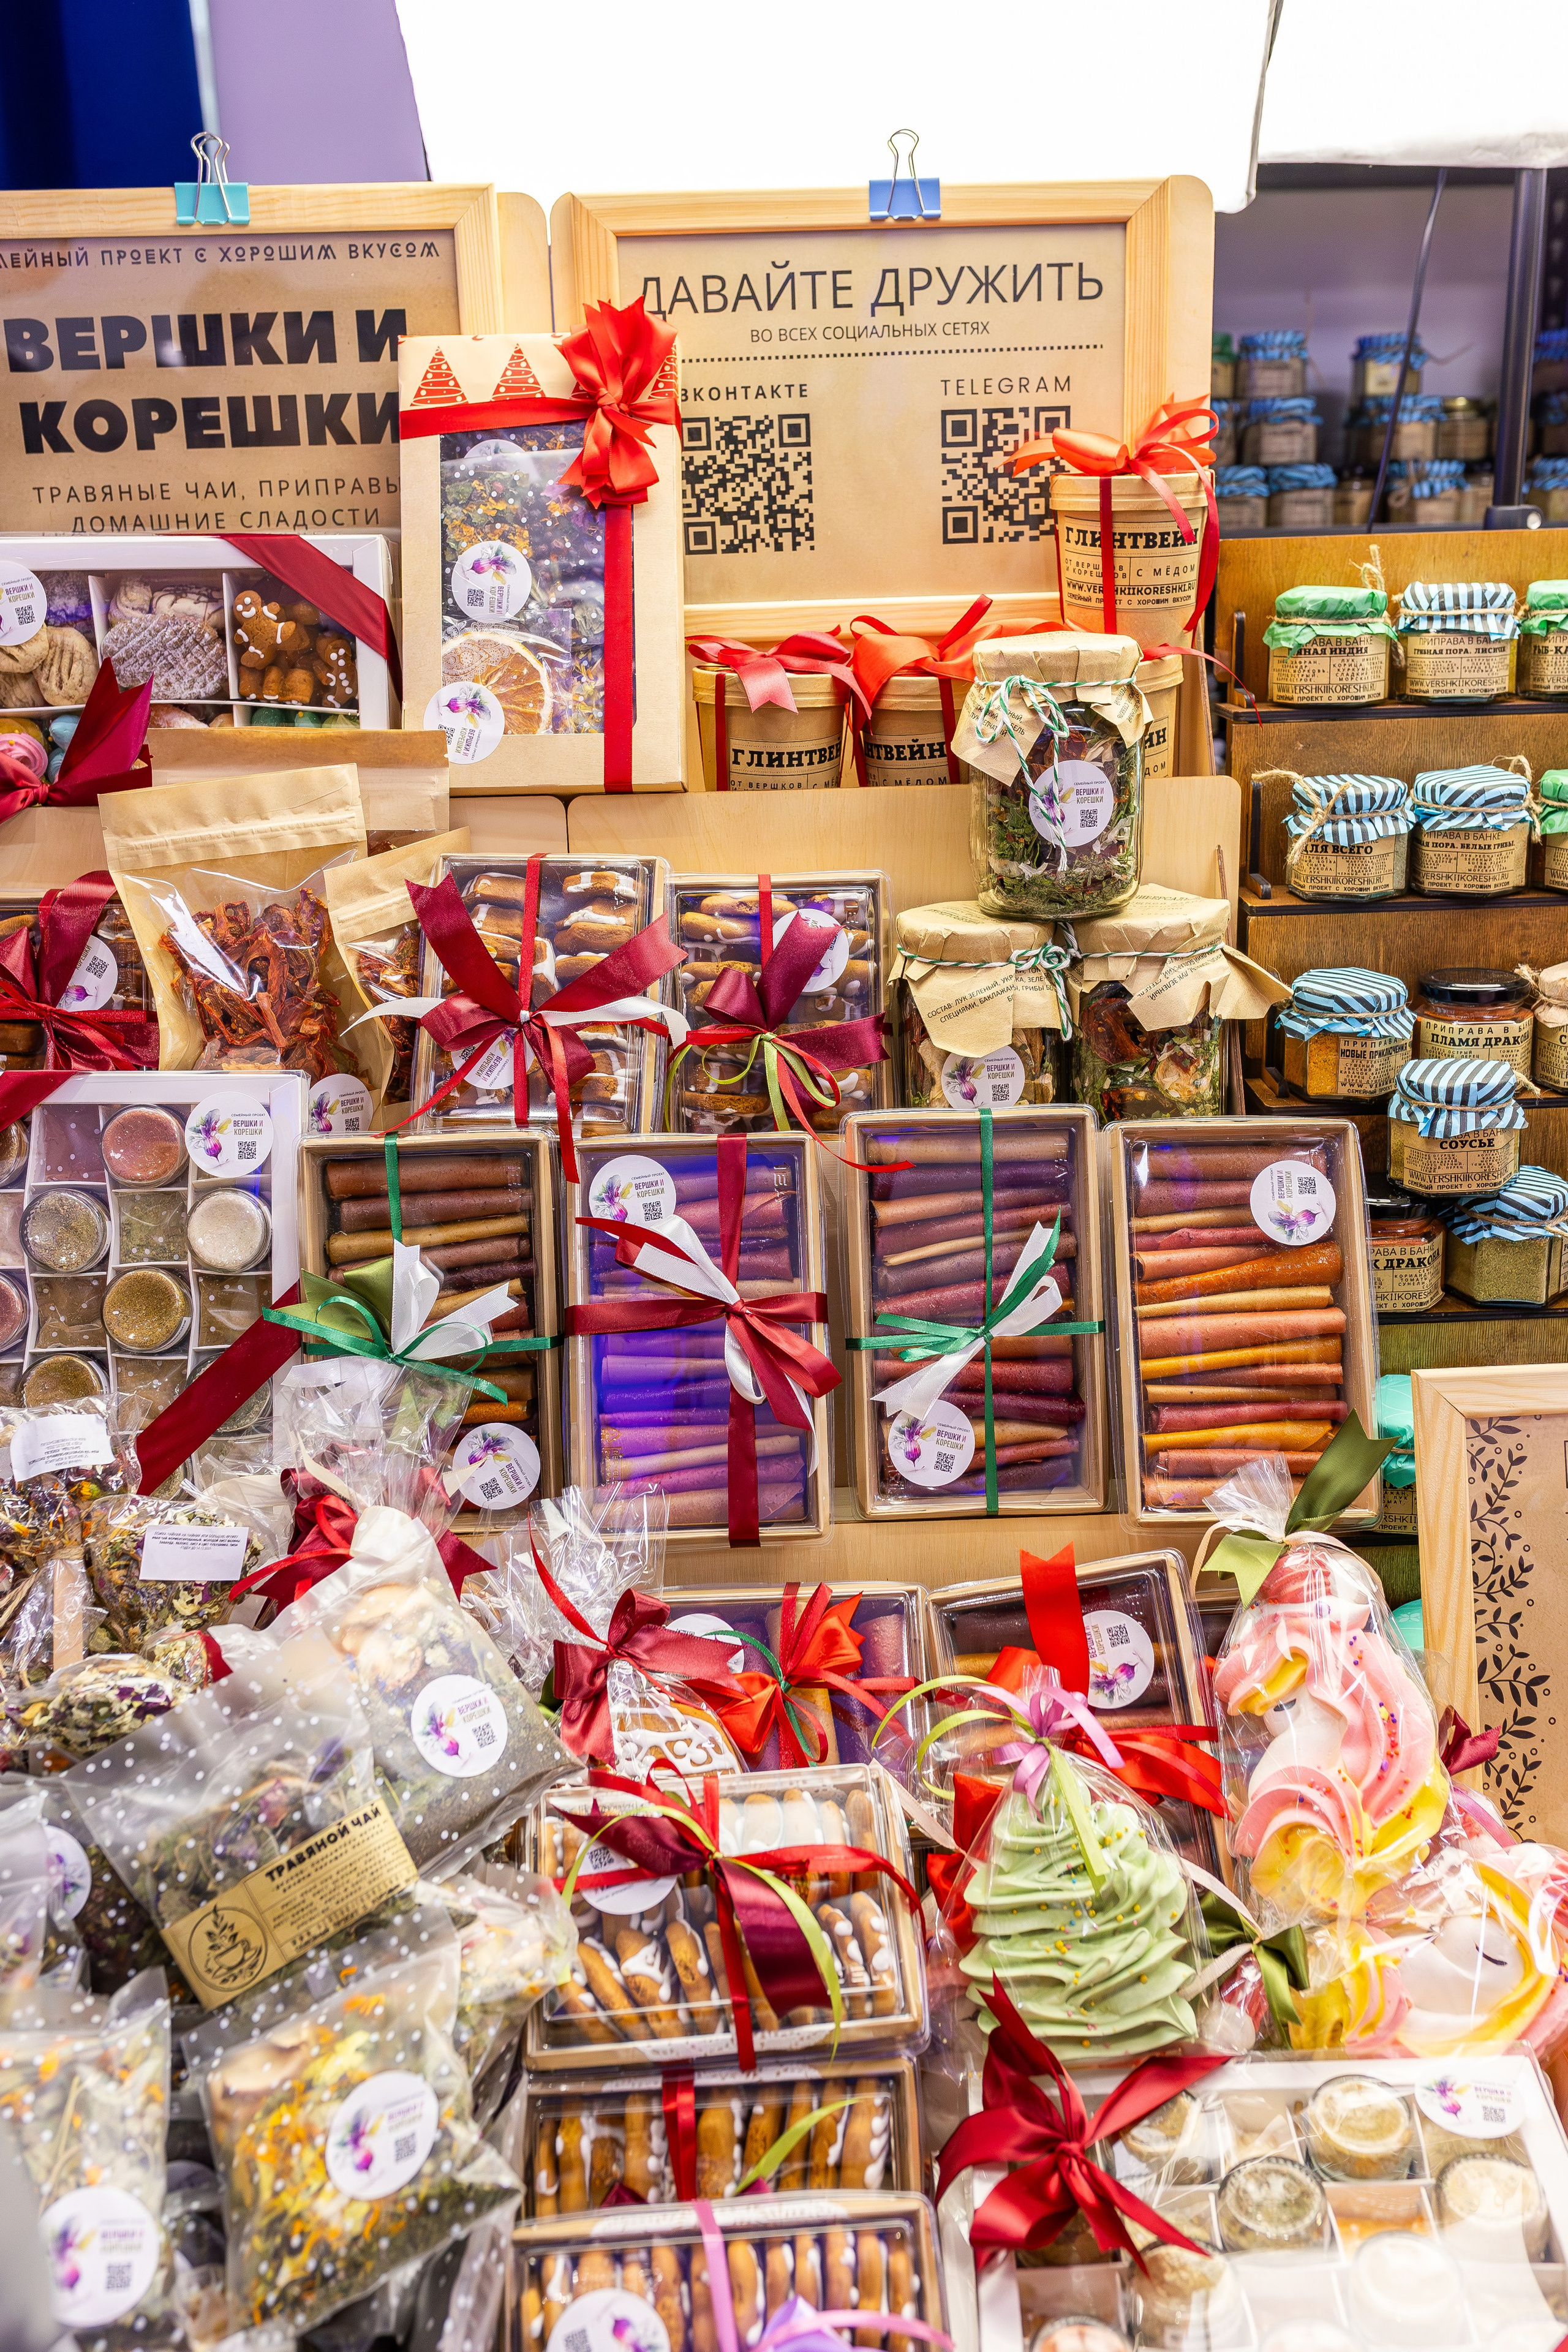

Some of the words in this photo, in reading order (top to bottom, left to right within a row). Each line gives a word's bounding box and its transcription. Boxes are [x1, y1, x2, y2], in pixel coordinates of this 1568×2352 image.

[101, 247, 182, 265] ПРОЕКТ
[195, 248, 207, 263] С
[219, 245, 337, 262] ХОРОШИМ
[349, 242, 440, 260] ВКУСОМ
[642, 260, 853, 322] ДАВАЙТЕ
[871, 262, 1104, 317] ДРУЖИТЬ
[3, 311, 337, 373] ВЕРШКИ
[355, 309, 407, 362] И
[751, 329, 772, 342] ВО
[779, 327, 817, 342] ВСЕХ
[823, 324, 937, 343] СОЦИАЛЬНЫХ
[942, 321, 990, 336] СЕТЯХ
[941, 375, 1072, 397] TELEGRAM
[19, 391, 399, 454] КОРЕШКИ
[32, 483, 170, 504] ТРАВЯНЫЕ
[186, 481, 245, 501] ЧАИ,
[72, 512, 225, 534] ДОМАШНИЕ
[240, 508, 380, 531] СЛАДОСТИ
[1137, 568, 1143, 577] С
[1153, 564, 1195, 577] МЁДОМ
[6, 584, 28, 595] ВЕРШКИ
[1067, 580, 1195, 595] WWW.VERHKIIKORESHKI.RU
[8, 592, 35, 603] КОРЕШКИ
[1336, 638, 1342, 646] В
[1346, 636, 1373, 646] БАНКЕ
[455, 727, 467, 754] КОРЕШКИ
[464, 729, 475, 751] ВЕРШКИ
[1077, 796, 1103, 804] КОРЕШКИ
[1332, 845, 1373, 855] ВСЕГО
[927, 1003, 954, 1019] СОСТАВ:
[954, 994, 968, 1006] ЛУК
[968, 981, 1001, 999] ЗЕЛЕНЫЙ,
[940, 1001, 979, 1023] СПЕЦИЯМИ,
[1427, 1022, 1493, 1035] ПРИПРАВА
[1344, 1038, 1397, 1047] ПРИПРАВА
[1431, 1033, 1480, 1047] ПЛАМЯ
[1483, 1030, 1529, 1049] ДРАКОНА
[1340, 1049, 1367, 1059] НОВЫЕ
[1369, 1042, 1408, 1059] ПРИКЛЮЧЕНИЯ
[475, 1052, 496, 1077] КОРЕШКИ
[485, 1056, 503, 1078] ВЕРШКИ
[341, 1098, 359, 1107] ВЕРШКИ
[341, 1104, 364, 1115] КОРЕШКИ
[1440, 1138, 1494, 1150] СОУСЬЕ
[635, 1180, 659, 1190] ВЕРШКИ
[637, 1188, 665, 1198] КОРЕШКИ
[1408, 1180, 1433, 1190] СЕМЕЙНЫЙ
[1400, 1247, 1407, 1256] В
[1410, 1242, 1434, 1256] БАНКЕ
[1384, 1247, 1440, 1270] ДРАКОНА
[936, 1438, 964, 1450] КОРЕШКИ
[937, 1429, 961, 1441] ВЕРШКИ
[499, 1468, 518, 1494] КОРЕШКИ
[505, 1463, 522, 1486] ВЕРШКИ
[265, 1822, 350, 1882] ТРАВЯНОЙ
[351, 1803, 381, 1827] ЧАЙ
